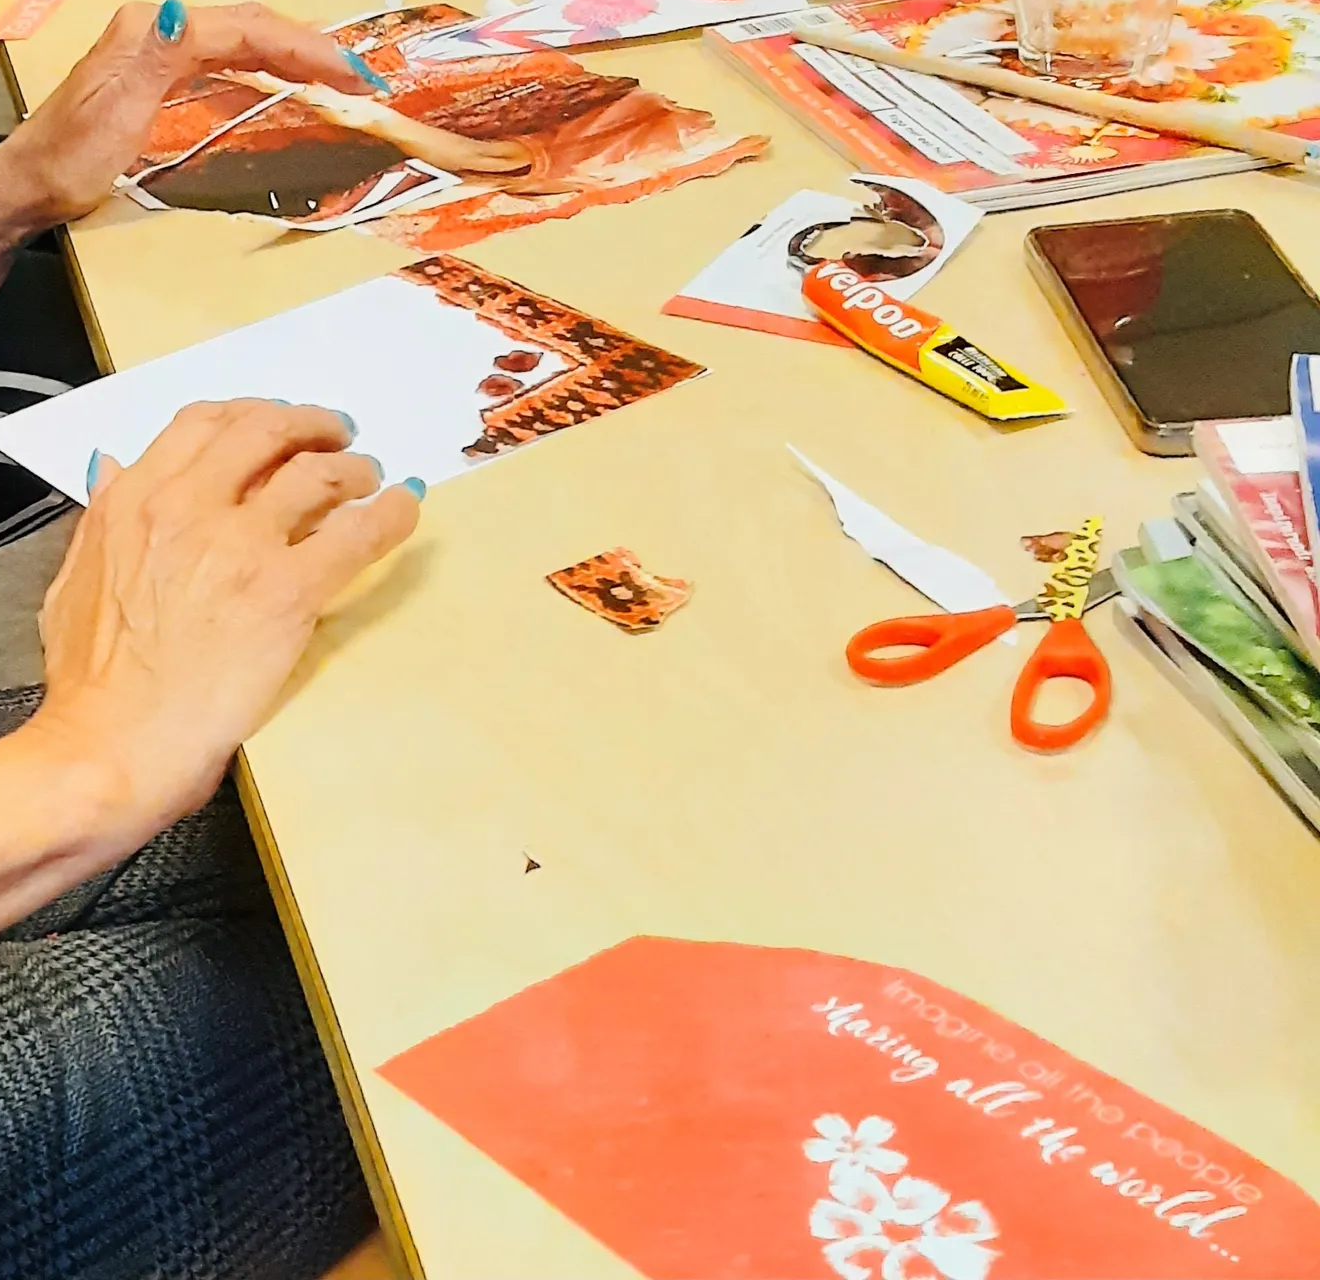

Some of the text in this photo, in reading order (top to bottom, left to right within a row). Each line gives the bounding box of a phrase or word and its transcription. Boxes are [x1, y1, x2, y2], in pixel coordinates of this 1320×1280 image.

[810, 995, 939, 1083] sharing
[945, 1078, 1043, 1118] all
[1021, 1116, 1087, 1165] the
[1120, 1122, 1264, 1205] people
